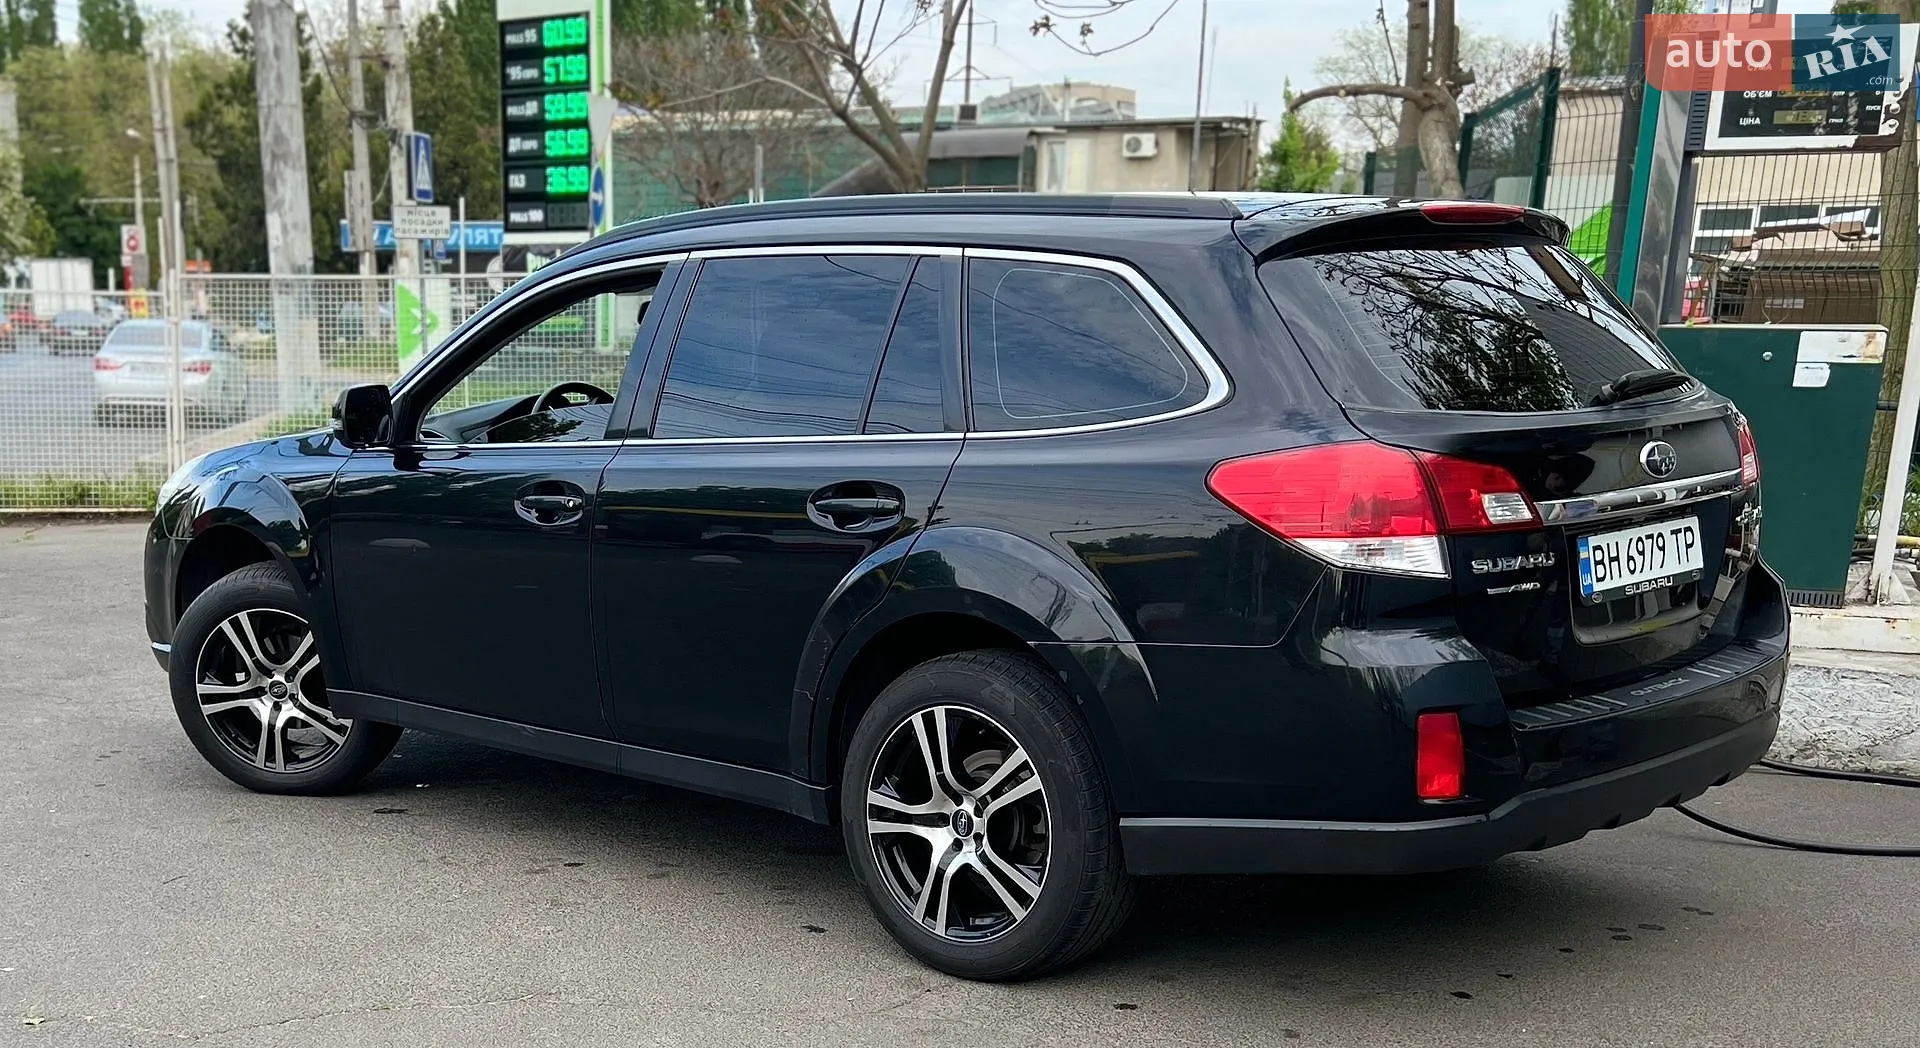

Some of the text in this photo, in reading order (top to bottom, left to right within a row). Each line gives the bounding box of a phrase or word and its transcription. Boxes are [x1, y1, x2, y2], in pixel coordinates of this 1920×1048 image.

[524, 28, 537, 43] 95
[1739, 117, 1761, 126] ЦІНА
[508, 174, 526, 189] ГАЗ
[528, 209, 544, 223] 100
[1592, 525, 1695, 583] BH 6979 TP
[1471, 552, 1555, 574] SUBARU
[1582, 573, 1592, 586] UA
[1625, 577, 1673, 595] SUBARU
